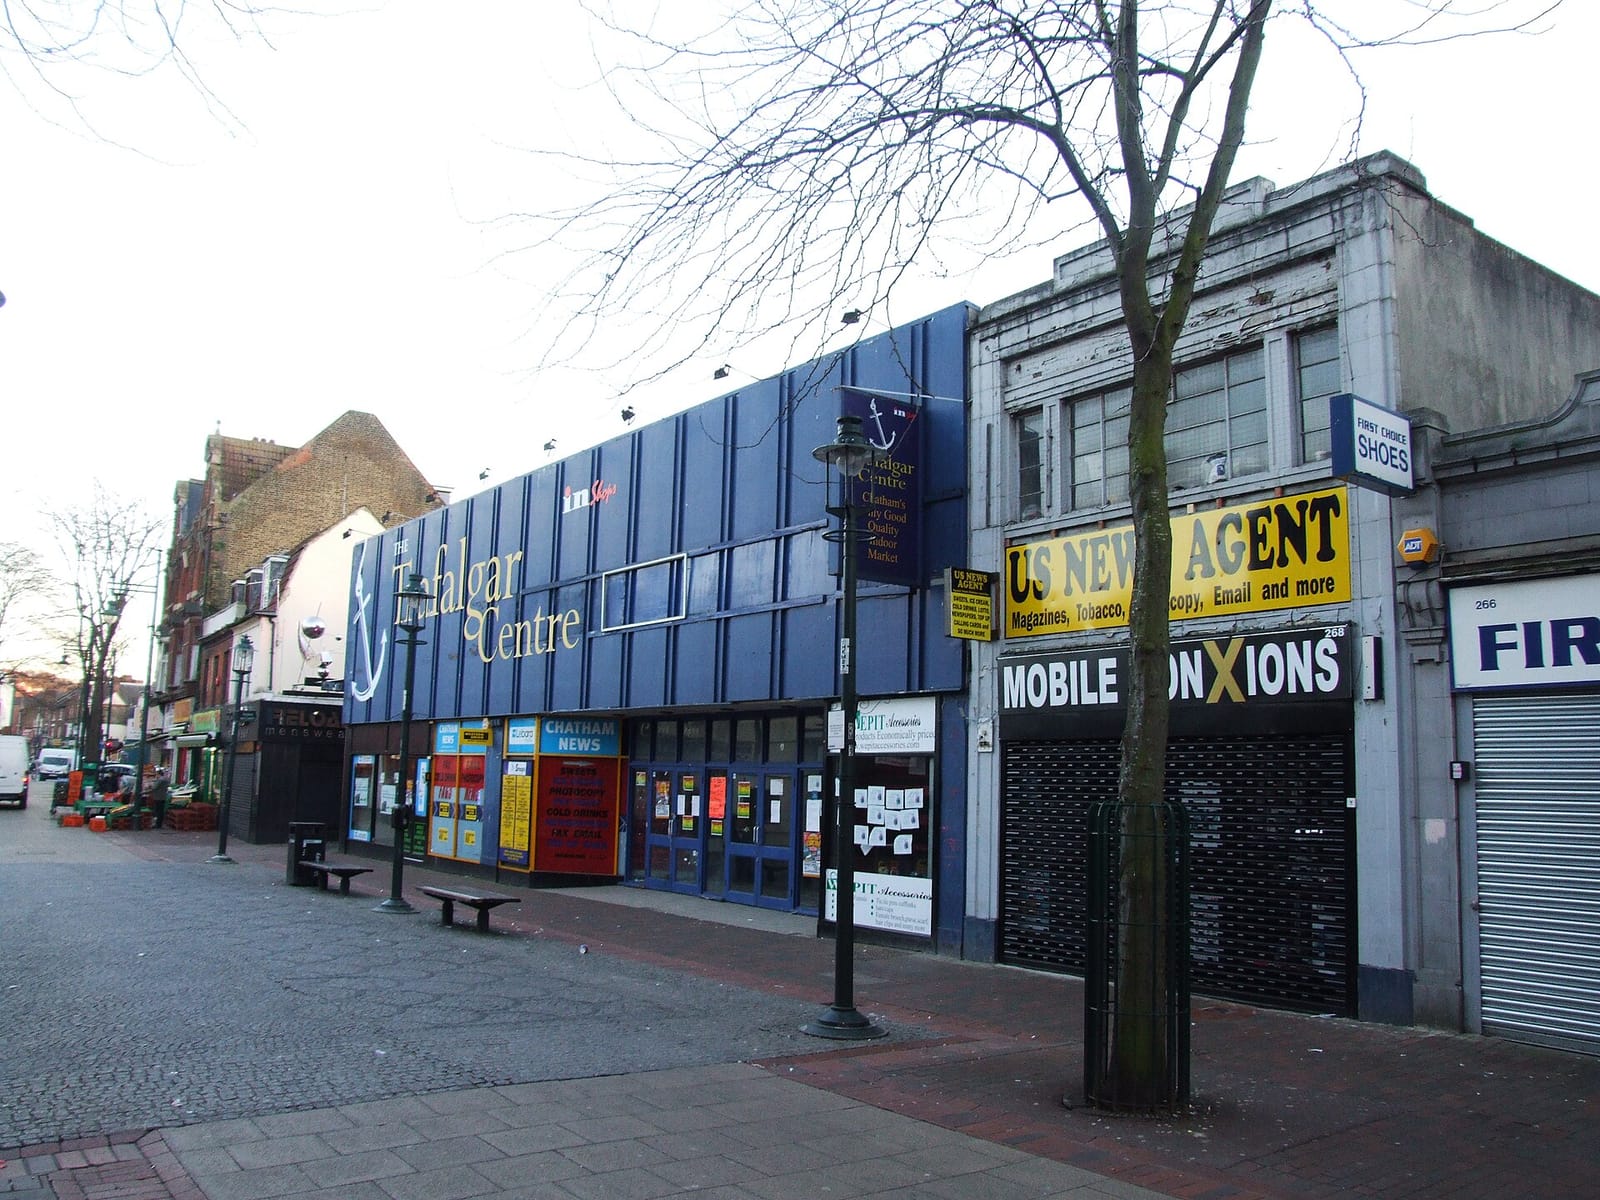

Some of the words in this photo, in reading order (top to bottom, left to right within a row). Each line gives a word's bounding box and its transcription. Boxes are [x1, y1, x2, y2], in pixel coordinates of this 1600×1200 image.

[1357, 416, 1379, 434] FIRST
[1380, 426, 1407, 446] CHOICE
[1358, 433, 1409, 473] SHOES
[862, 491, 906, 510] Catham's
[884, 509, 907, 524] Good
[867, 520, 899, 538] Quality
[393, 539, 409, 557] THE
[1008, 545, 1051, 604] US
[1063, 527, 1136, 597] NEW
[1184, 494, 1342, 582] AGENT
[1403, 537, 1422, 553] ADT
[867, 548, 898, 564] Market
[954, 570, 965, 580] US
[966, 572, 988, 583] NEWS
[957, 579, 984, 590] AGENT
[1011, 607, 1071, 631] Magazines,
[1076, 601, 1127, 623] Tobacco,
[1213, 582, 1252, 606] Email
[1262, 579, 1289, 600] and
[1295, 573, 1336, 597] more
[1475, 599, 1497, 610] 266
[476, 606, 581, 663] Centre
[1324, 627, 1345, 639] 268
[1003, 656, 1119, 710] MOBILE
[1168, 637, 1341, 704] NXIONS
[545, 720, 615, 735] CHATHAM
[886, 712, 921, 728] Accessories
[876, 729, 916, 742] Economically
[558, 738, 601, 751] NEWS
[549, 787, 606, 797] PHOTOCOPY
[546, 808, 570, 817] COLD
[573, 808, 608, 818] DRINKS
[878, 886, 933, 901] Accessories
